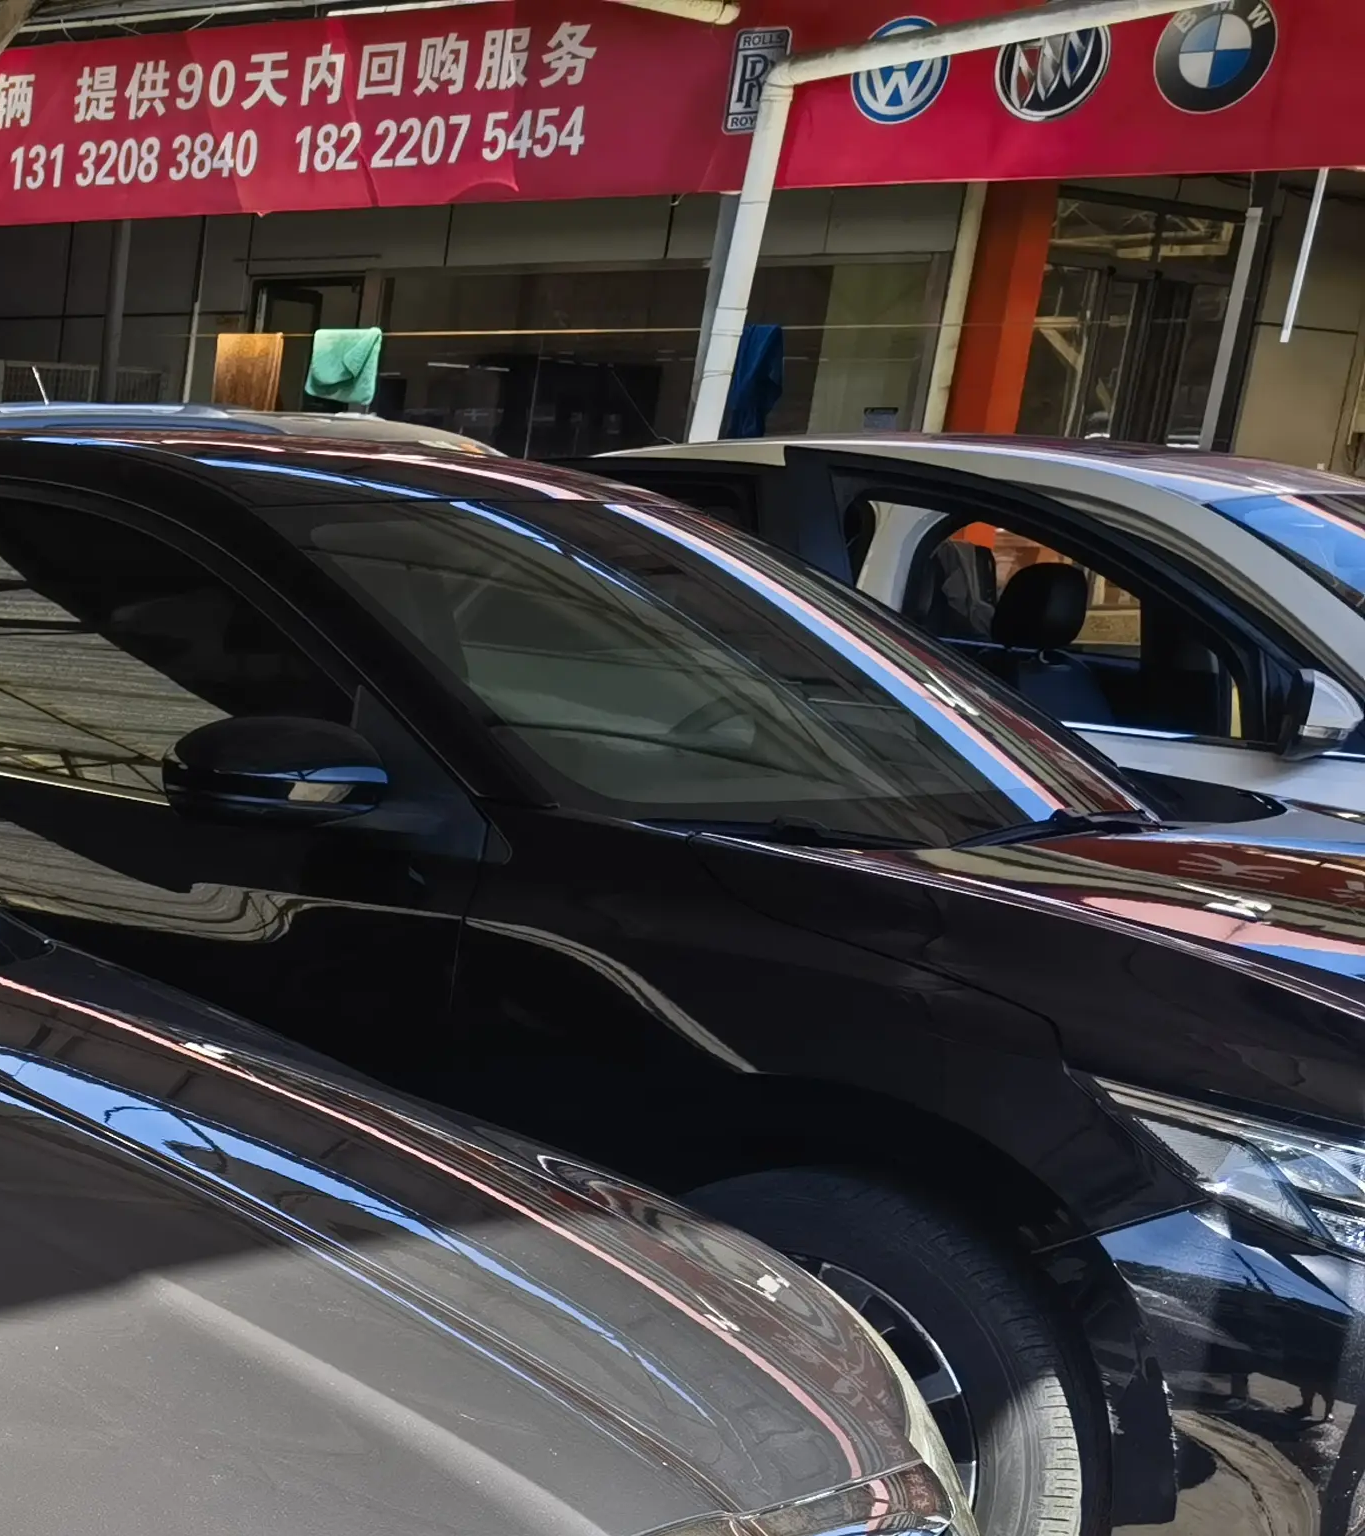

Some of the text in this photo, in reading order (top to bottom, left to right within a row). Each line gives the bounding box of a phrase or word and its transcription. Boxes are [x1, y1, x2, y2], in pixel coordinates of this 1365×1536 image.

[743, 34, 784, 48] ROLLS
[74, 21, 597, 124] 提供90天内回购服务
[730, 115, 757, 128] ROY
[10, 143, 65, 190] 131
[75, 136, 160, 187] 3208
[169, 129, 258, 181] 3840
[295, 121, 362, 173] 182
[370, 114, 471, 168] 2207
[482, 105, 585, 162] 5454
